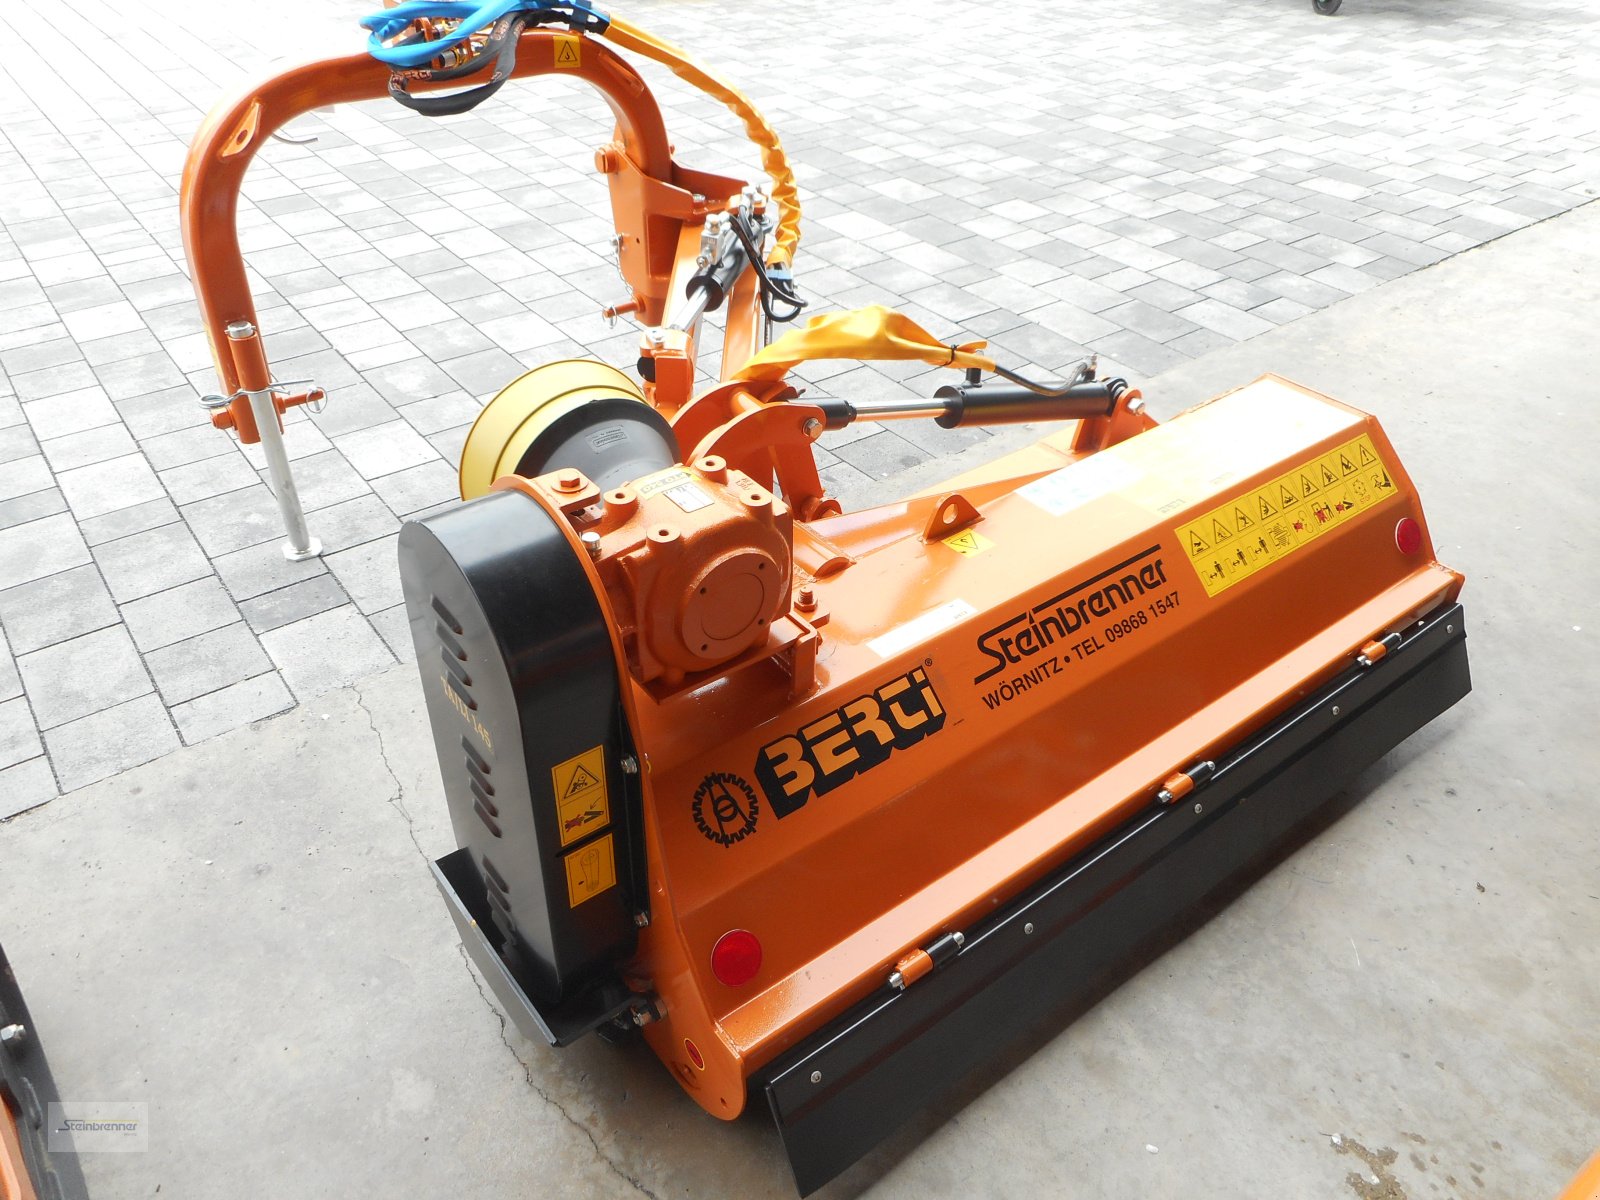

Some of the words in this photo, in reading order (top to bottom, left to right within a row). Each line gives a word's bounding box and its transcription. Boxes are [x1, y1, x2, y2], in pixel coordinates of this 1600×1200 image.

[974, 543, 1168, 685] Steinbrenner
[982, 658, 1063, 710] WÖRNITZ
[1071, 636, 1105, 660] TEL
[1105, 610, 1148, 643] 09868
[1148, 591, 1180, 618] 1547
